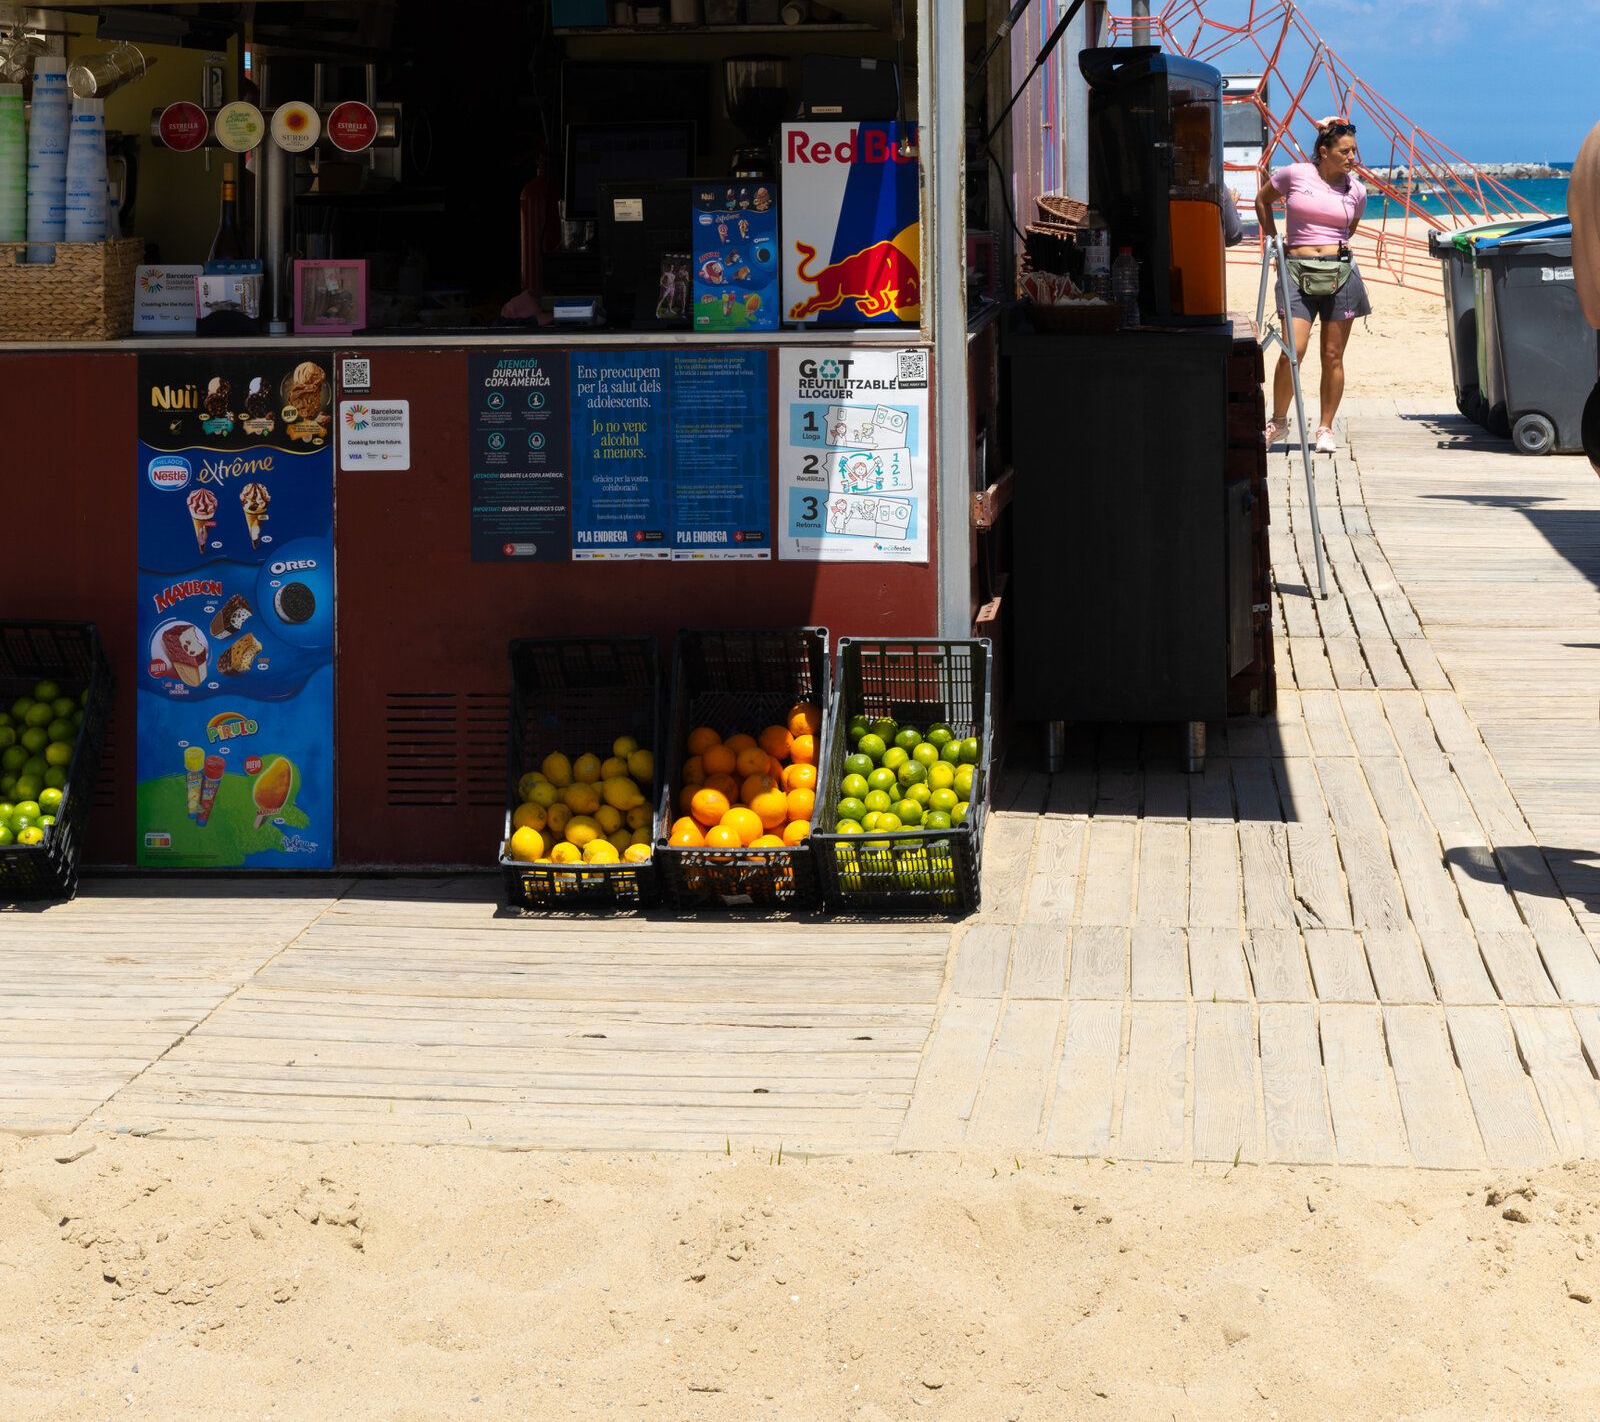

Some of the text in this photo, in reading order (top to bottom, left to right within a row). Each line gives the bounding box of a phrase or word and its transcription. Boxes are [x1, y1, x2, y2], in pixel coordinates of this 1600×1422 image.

[168, 122, 199, 130] ESTRELLA
[337, 122, 368, 130] ESTRELLA
[787, 128, 858, 164] Red
[497, 358, 538, 369] ATENCIÓ!
[493, 368, 542, 378] DURANT LA
[577, 365, 661, 382] Ens preocupem
[485, 376, 551, 387] COPA AMÈRICA
[798, 379, 897, 390] REUTILITZABLE
[577, 379, 662, 397] per la salut dels
[798, 390, 853, 399] LLOGUER
[587, 395, 652, 409] adolescents.
[592, 419, 647, 436] Jo no venc
[803, 411, 819, 432] 1
[601, 433, 639, 446] alcohol
[802, 433, 820, 441] Lloga
[593, 448, 647, 458] a menors.
[893, 453, 900, 463] 1
[802, 454, 819, 475] 2
[891, 464, 901, 475] 2
[614, 476, 624, 484] per
[801, 496, 818, 521] 3
[796, 521, 821, 529] Retorna
[577, 530, 628, 543] PLA ENDREÇA
[676, 530, 691, 543] PLA
[693, 530, 728, 543] ENDREÇA
[269, 559, 317, 575] OREO
[153, 580, 222, 614] MAXIBON
